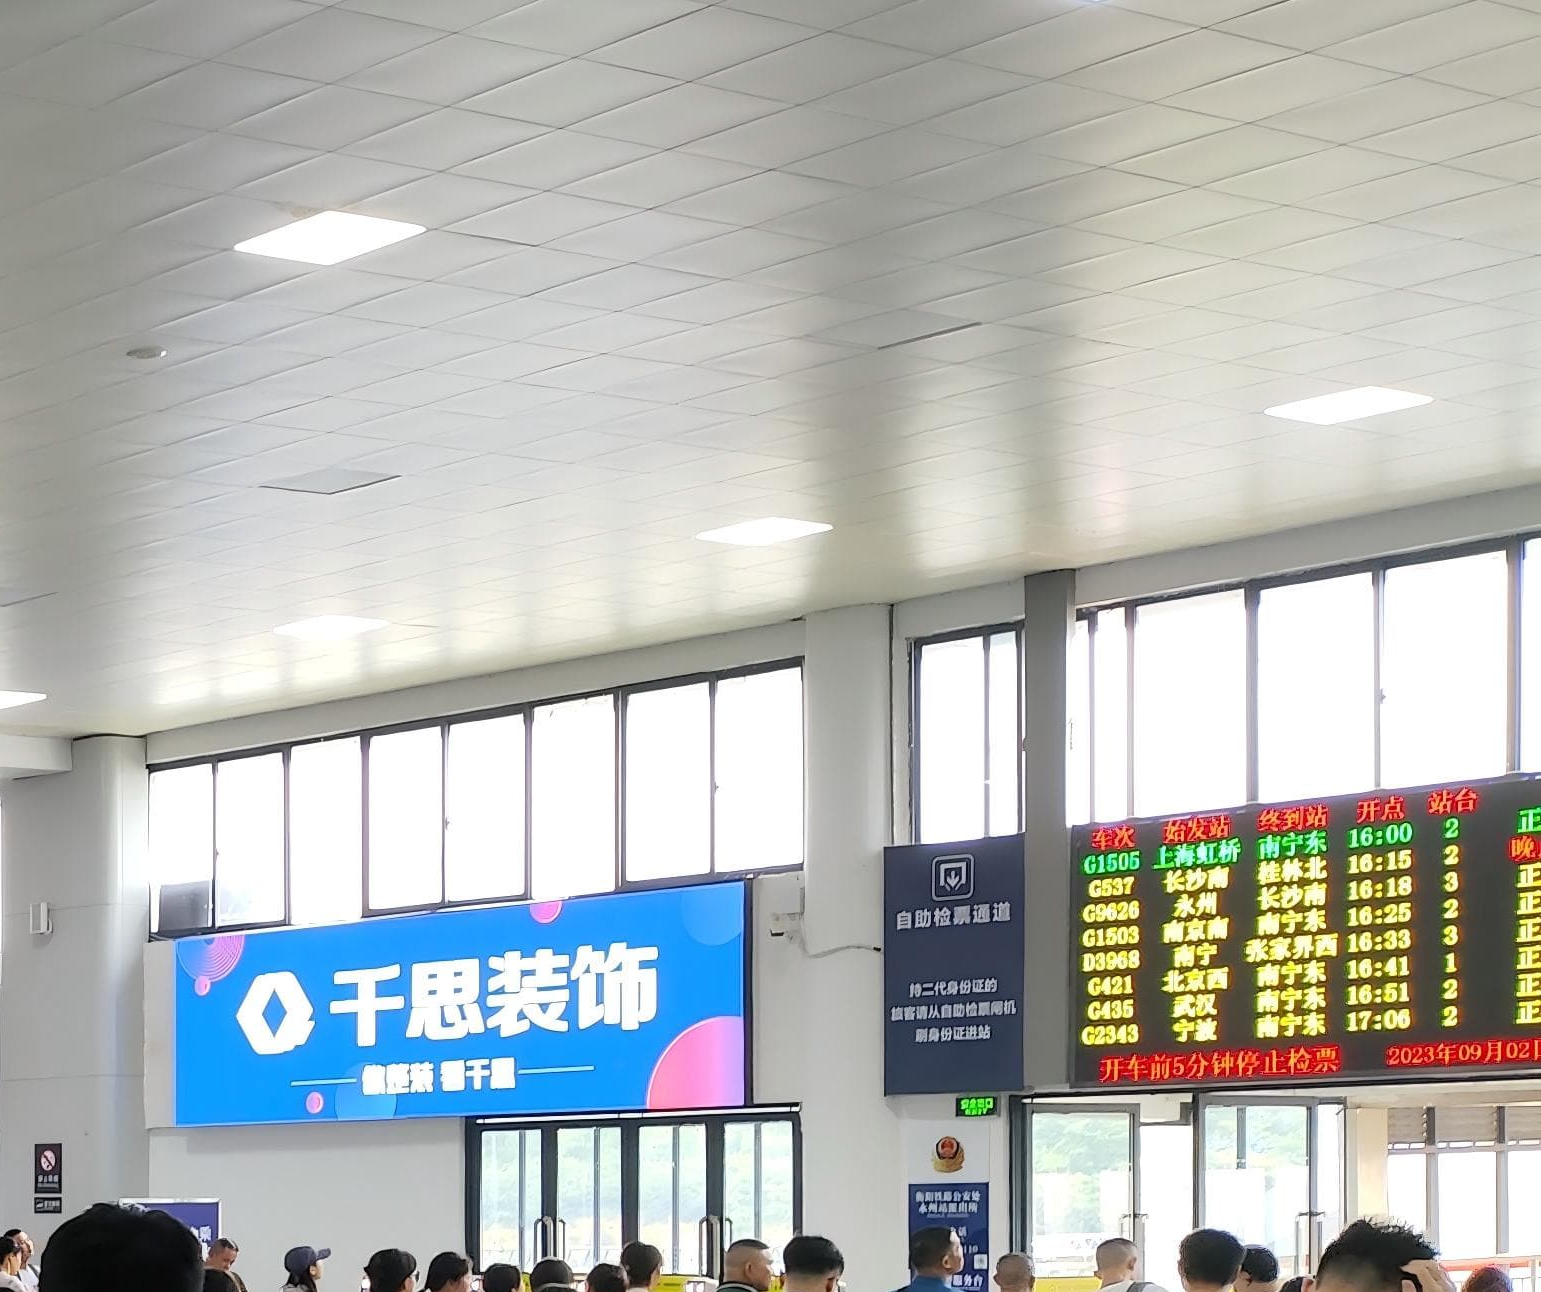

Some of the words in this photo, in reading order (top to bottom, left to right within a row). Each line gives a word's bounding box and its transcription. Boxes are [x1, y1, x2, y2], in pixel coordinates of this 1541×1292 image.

[1092, 826, 1136, 850] 车次
[1163, 815, 1231, 844] 始发站
[1257, 803, 1329, 832] 终到站
[1356, 795, 1405, 824] 开点
[1428, 787, 1479, 815] 站台
[1083, 851, 1141, 875] G1505
[1153, 838, 1241, 870] 上海虹桥
[1258, 830, 1327, 860] 南宁东
[1348, 822, 1413, 849] 16:00
[1444, 817, 1460, 839] 2
[1088, 876, 1135, 898] G537
[1163, 866, 1230, 893] 长沙南
[1258, 856, 1328, 885] 桂林北
[1347, 850, 1412, 875] 16:15
[1443, 844, 1459, 866] 2
[1511, 835, 1541, 862] 晚
[896, 901, 1011, 930] 自助检票通道
[1082, 901, 1140, 924] G9626
[1173, 892, 1217, 918] 永州
[1257, 882, 1328, 911] 长沙南
[1347, 875, 1413, 901] 16:18
[1444, 871, 1459, 892] 3
[1082, 926, 1140, 948] G1503
[1162, 916, 1229, 943] 南京南
[1257, 908, 1327, 937] 南宁东
[1347, 902, 1412, 927] 16:25
[1443, 898, 1459, 919] 2
[1082, 950, 1140, 973] D3968
[1173, 943, 1217, 968] 南宁
[1245, 933, 1339, 963] 张家界西
[1347, 929, 1412, 953] 16:33
[1443, 925, 1459, 946] 3
[328, 941, 659, 1048] 千思装饰
[909, 977, 998, 998] 持二代身份证的
[1087, 975, 1133, 997] G421
[1161, 967, 1229, 993] 北京西
[1257, 960, 1327, 987] 南宁东
[1346, 956, 1410, 980] 16:41
[1444, 952, 1458, 973] 1
[890, 1000, 1017, 1021] 旅客请从自助检票闸机
[1087, 999, 1134, 1021] G435
[1172, 993, 1218, 1019] 武汉
[1256, 986, 1327, 1013] 南宁东
[1346, 982, 1410, 1006] 16:51
[1442, 978, 1458, 1000] 2
[915, 1024, 991, 1042] 刷身份证进站
[1081, 1023, 1140, 1046] G2343
[1172, 1018, 1218, 1043] 宁波
[1255, 1012, 1326, 1039] 南宁东
[1346, 1008, 1411, 1032] 17:06
[1442, 1005, 1458, 1027] 2
[1100, 1045, 1341, 1083] 开车前5分钟停止检票
